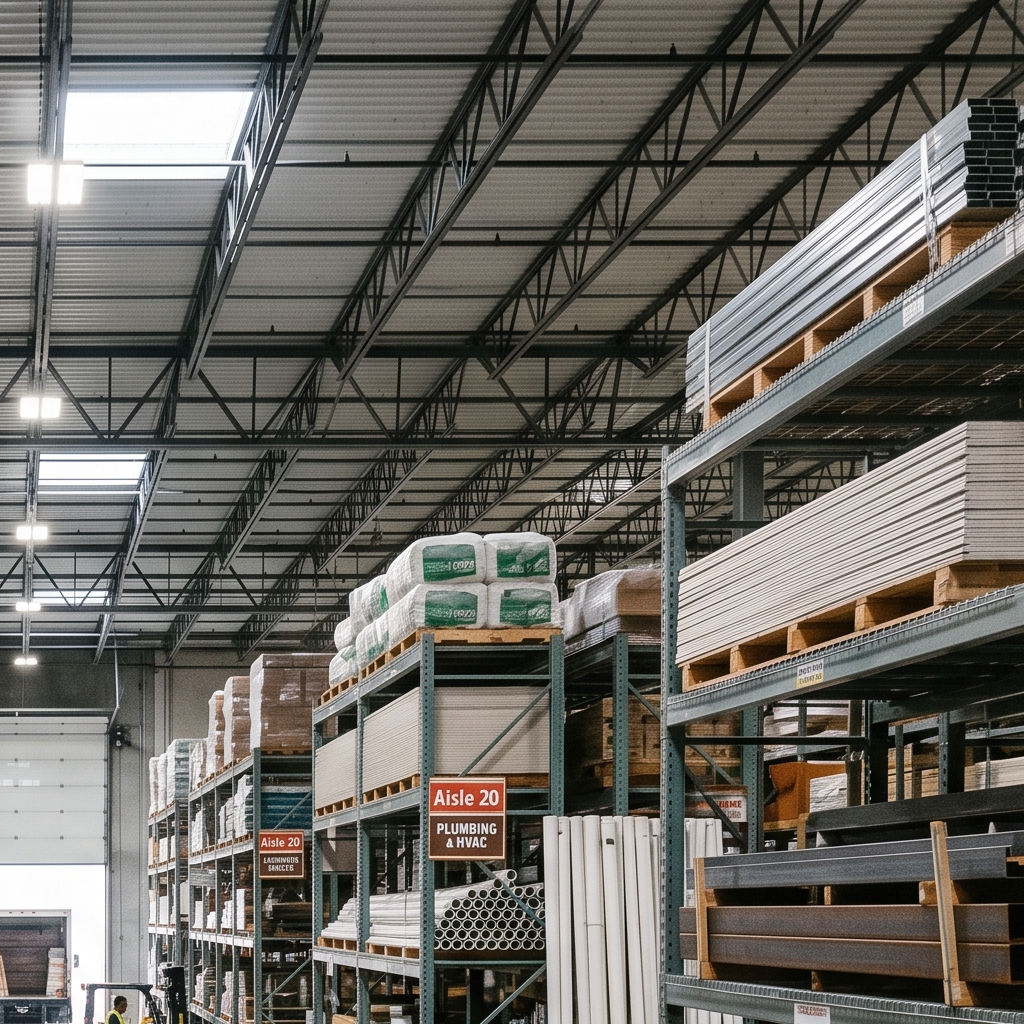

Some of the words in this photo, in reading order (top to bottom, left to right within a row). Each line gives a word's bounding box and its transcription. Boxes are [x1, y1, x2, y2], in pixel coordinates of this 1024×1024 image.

[433, 789, 475, 807] Aisle
[478, 789, 500, 807] 20
[436, 822, 498, 835] PLUMBING
[261, 837, 285, 848] Aisle
[287, 837, 300, 847] 20
[456, 836, 487, 849] HVAC
